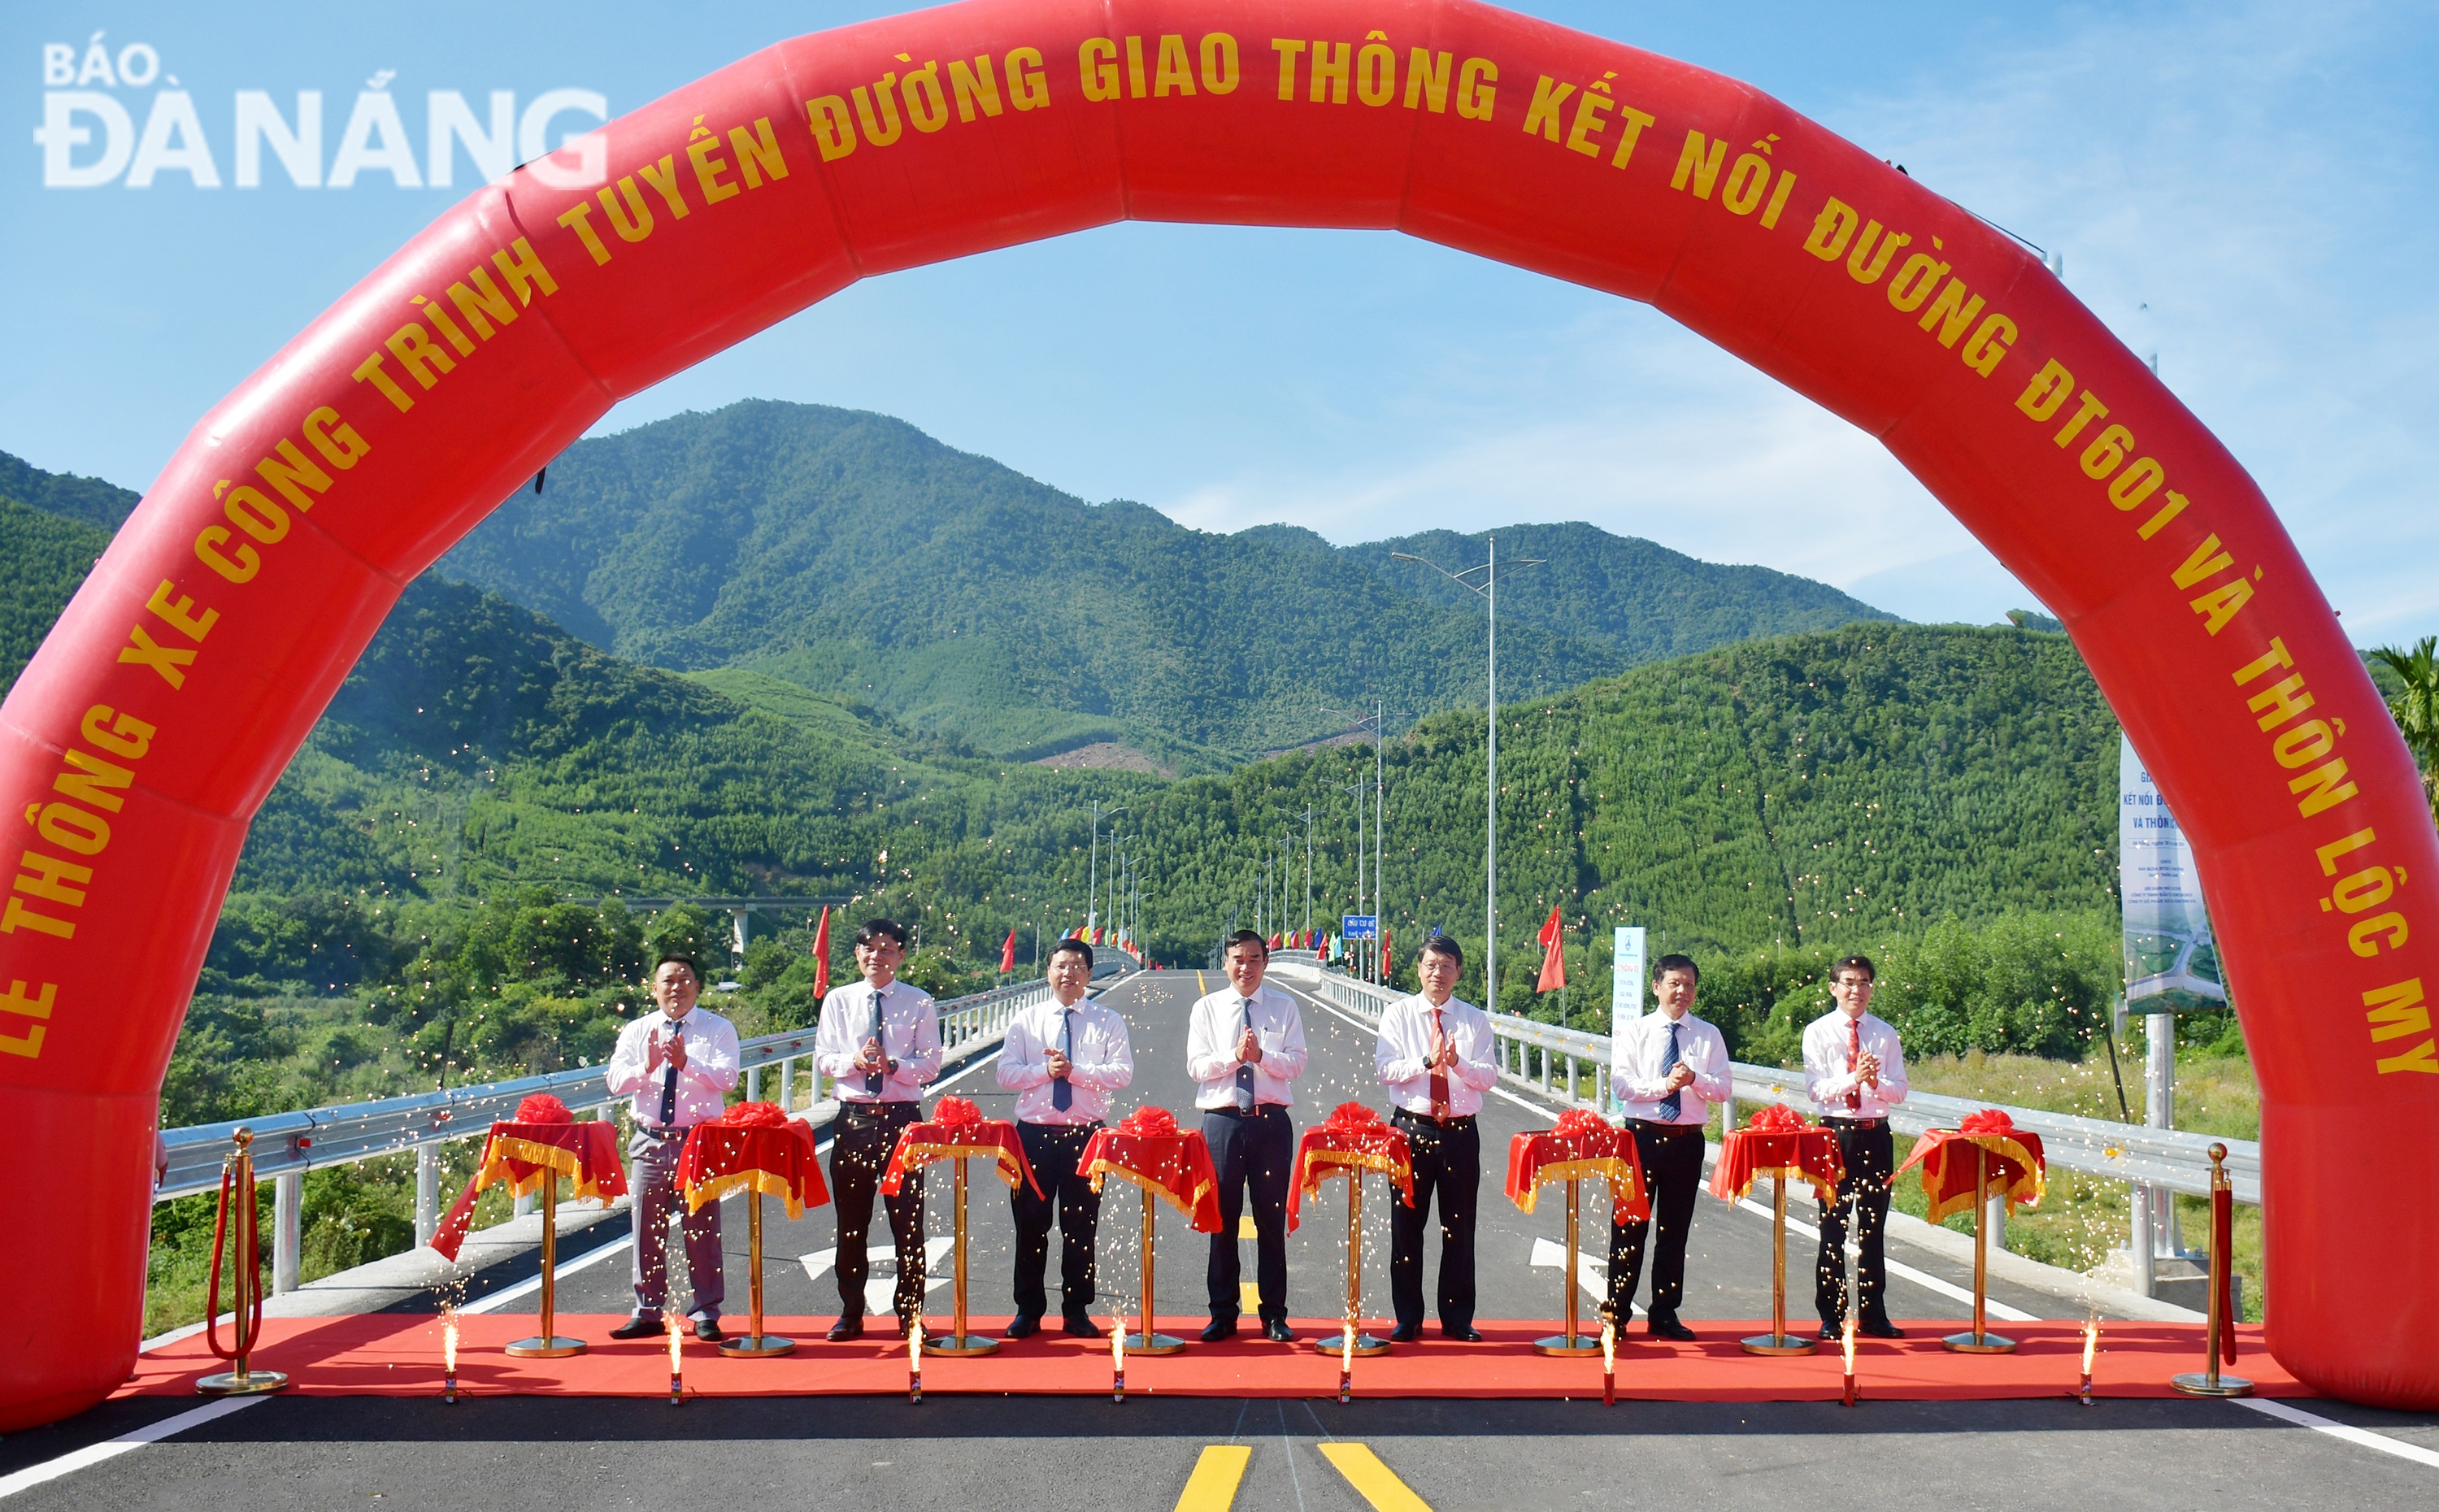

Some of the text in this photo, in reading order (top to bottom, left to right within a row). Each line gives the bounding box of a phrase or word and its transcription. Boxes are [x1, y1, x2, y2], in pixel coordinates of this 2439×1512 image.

[0, 704, 157, 939] THÔNG
[118, 579, 220, 689] XE
[195, 406, 371, 584] CÔNG
[352, 237, 559, 413] TRÌNH
[556, 114, 789, 267] TUYẾN
[805, 52, 1051, 163] ĐƯỜNG
[1078, 31, 1240, 103] GIAO
[1271, 29, 1499, 122] THÔNG
[1522, 71, 1655, 170] KẾT
[1669, 133, 1798, 231] NỐI
[1802, 195, 2019, 380] ĐƯỜNG
[2015, 357, 2190, 542] ĐT601
[2170, 532, 2263, 637] VÀ
[2231, 635, 2360, 819] THÔN
[2315, 826, 2410, 959] LỘC
[2133, 815, 2143, 828] VÀ
